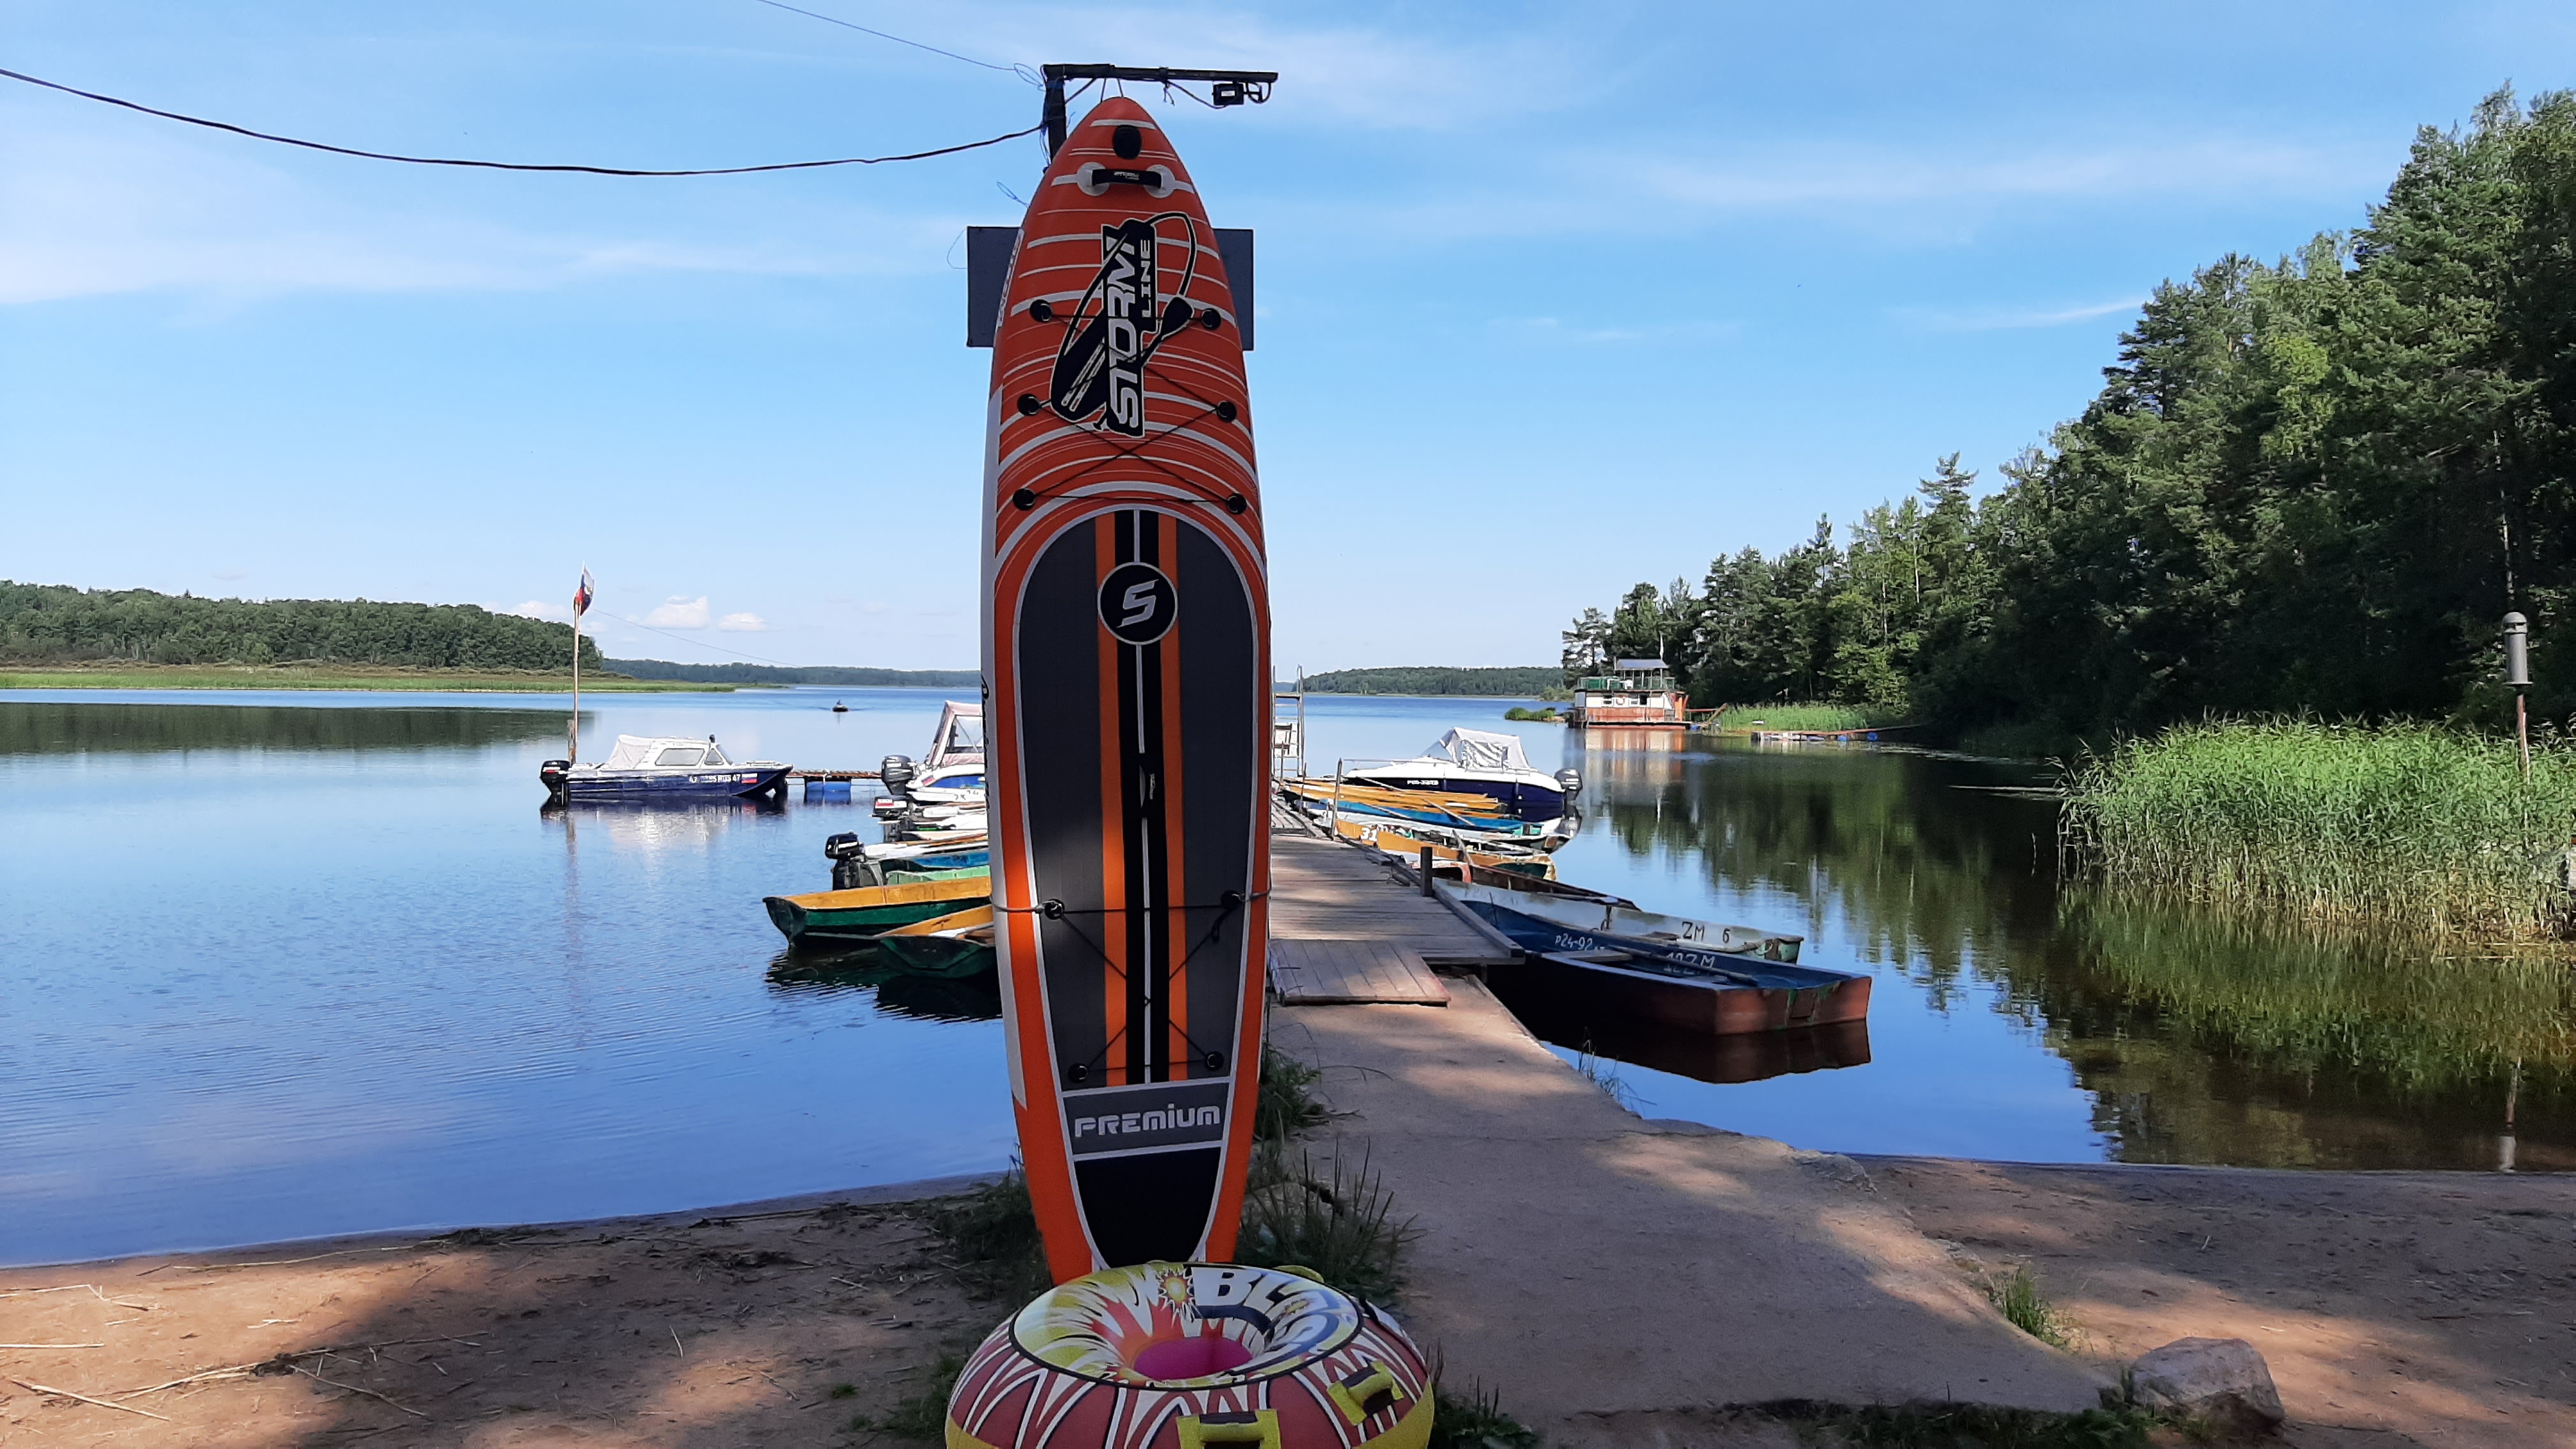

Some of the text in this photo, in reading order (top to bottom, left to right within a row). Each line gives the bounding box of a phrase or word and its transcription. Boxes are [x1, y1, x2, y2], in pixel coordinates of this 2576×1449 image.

[1140, 240, 1151, 318] LINE
[1107, 235, 1138, 429] STORM
[1361, 827, 1377, 842] 31
[1682, 921, 1731, 944] ZM 6
